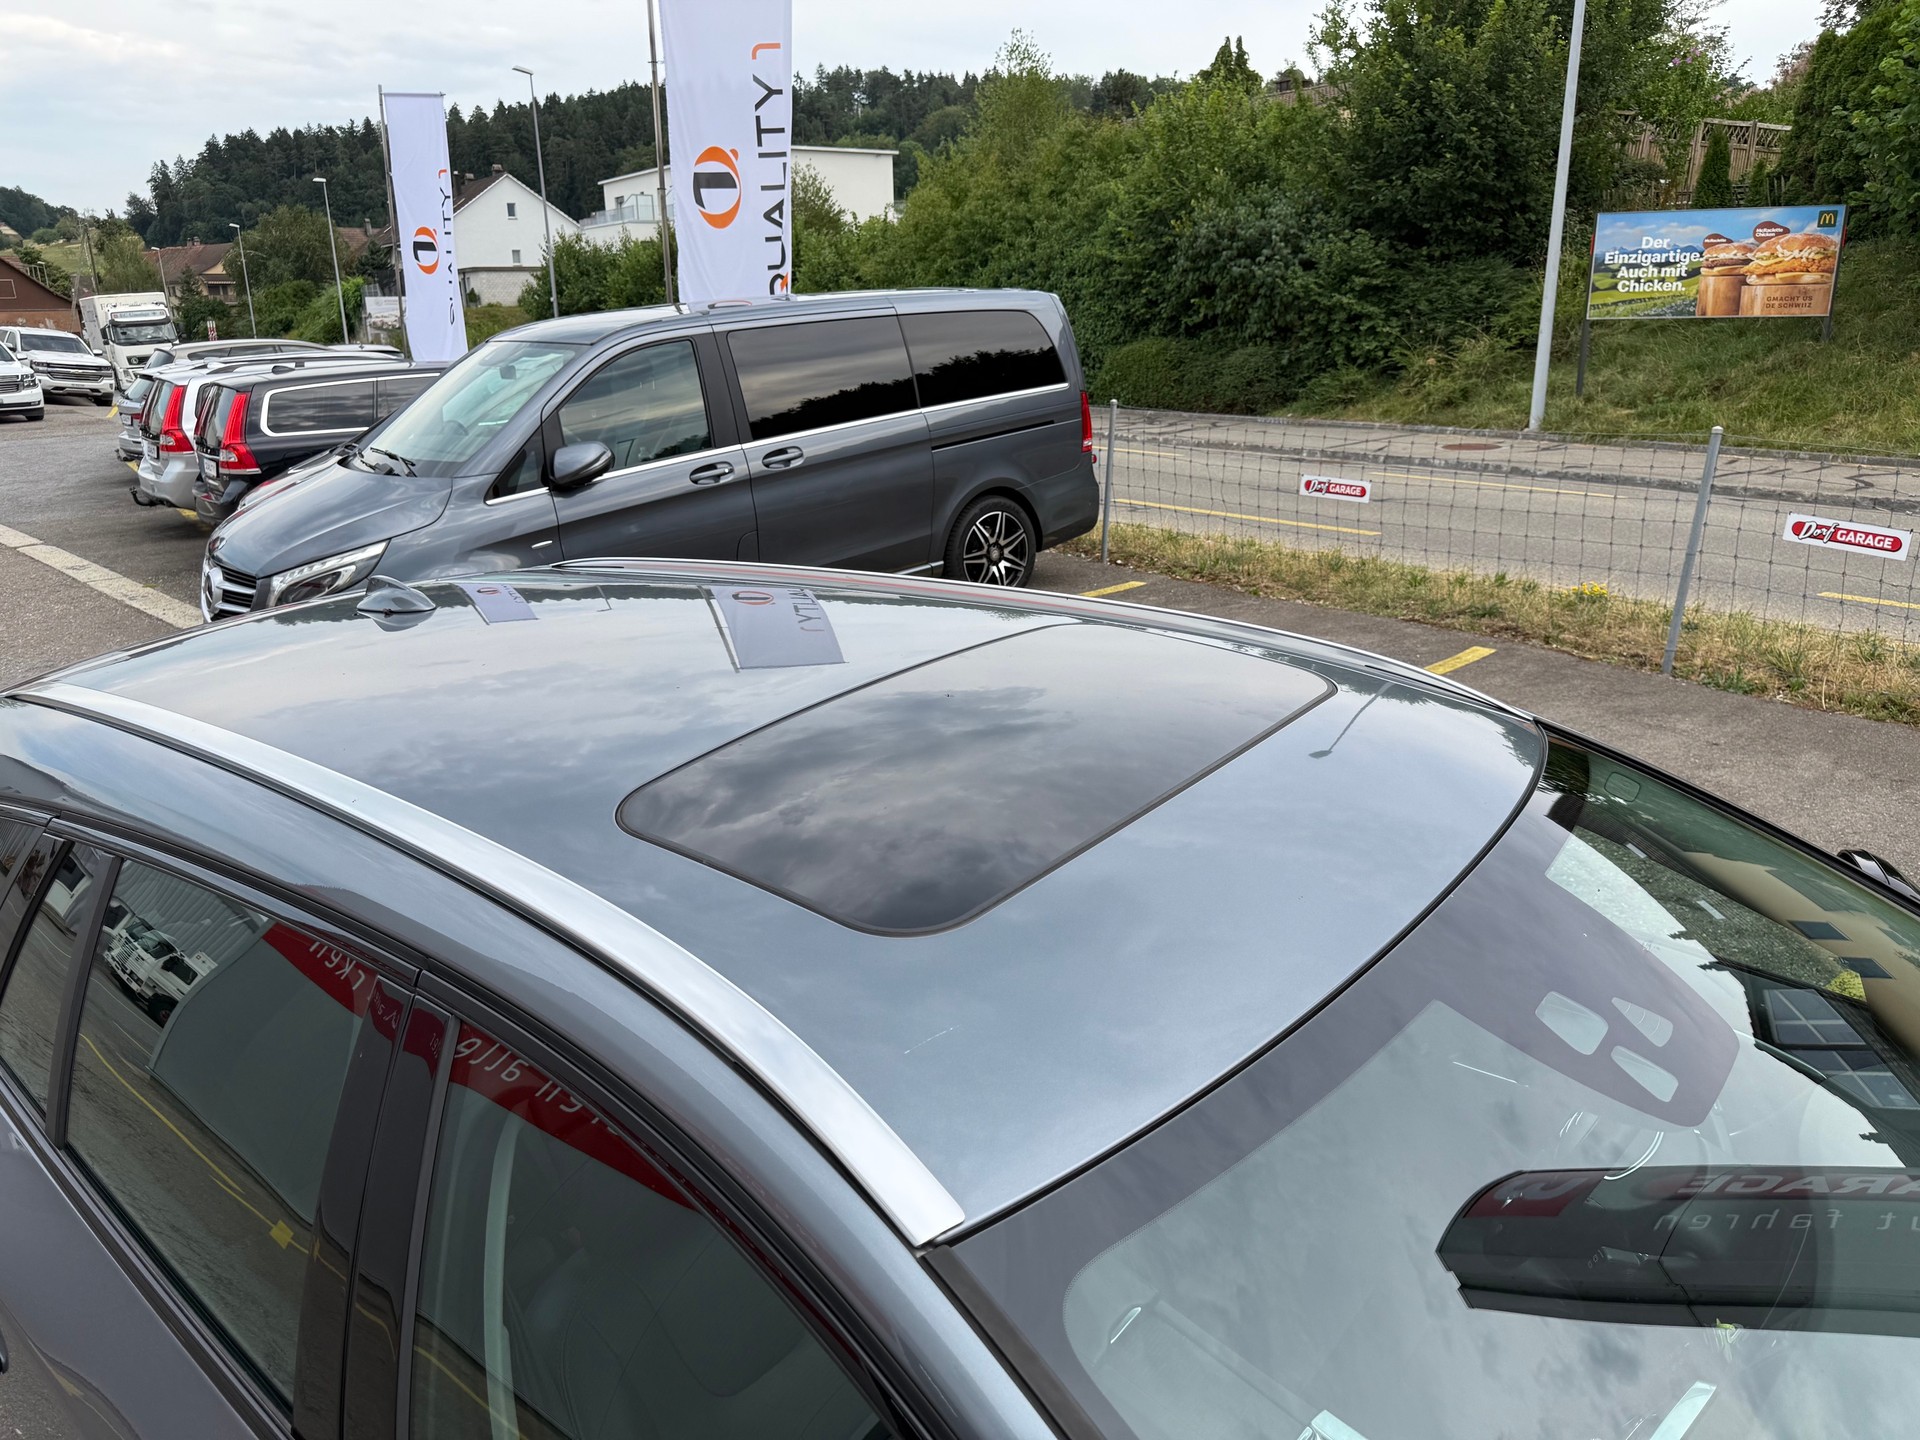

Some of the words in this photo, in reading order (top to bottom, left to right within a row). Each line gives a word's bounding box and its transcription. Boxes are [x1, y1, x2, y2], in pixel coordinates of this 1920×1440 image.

[1641, 236, 1670, 249] Der
[1617, 265, 1657, 278] Auch
[1660, 265, 1687, 277] mit
[1617, 280, 1686, 293] Chicken.
[1329, 484, 1361, 495] GARAGE
[1798, 521, 1839, 544] Dorf
[1836, 529, 1894, 549] GARAGE
